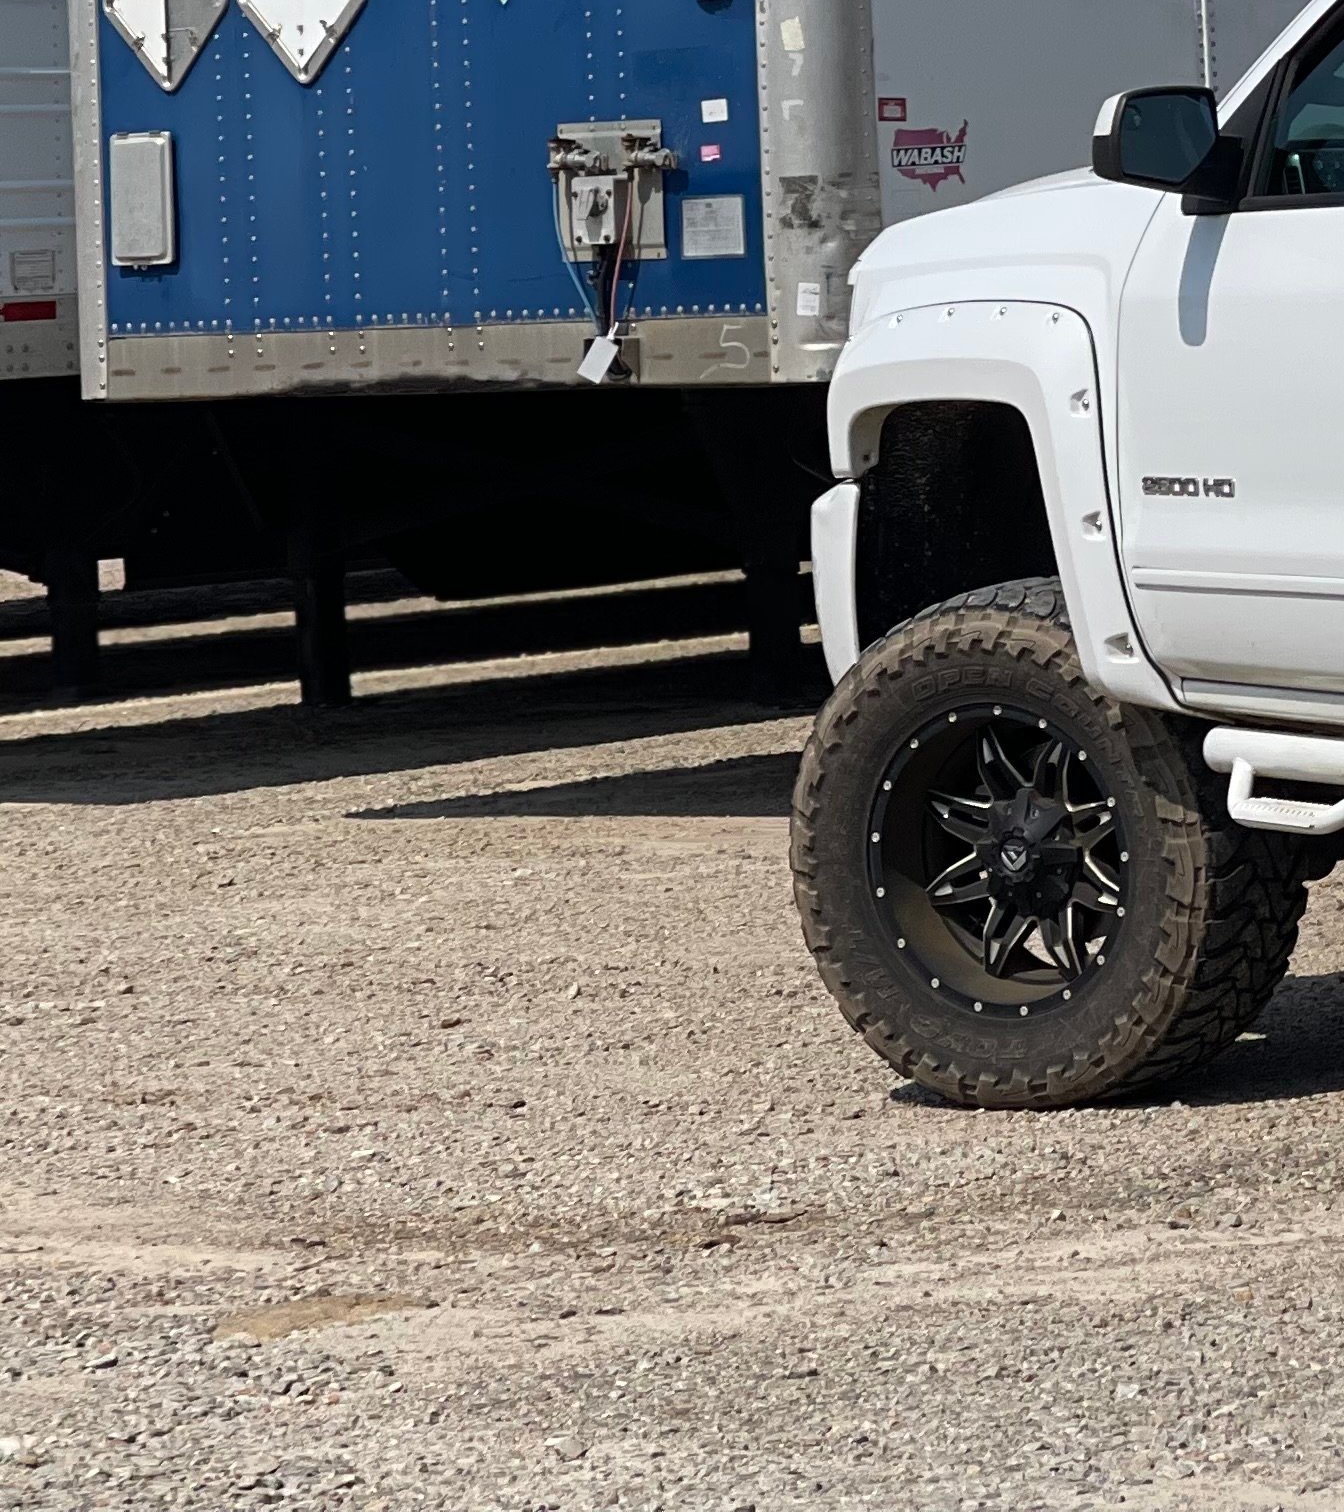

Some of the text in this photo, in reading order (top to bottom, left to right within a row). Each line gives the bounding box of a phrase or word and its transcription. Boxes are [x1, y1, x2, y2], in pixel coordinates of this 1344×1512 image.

[893, 145, 966, 166] WABASH
[1142, 476, 1236, 499] 2500 HD
[911, 666, 1014, 701] OPEN
